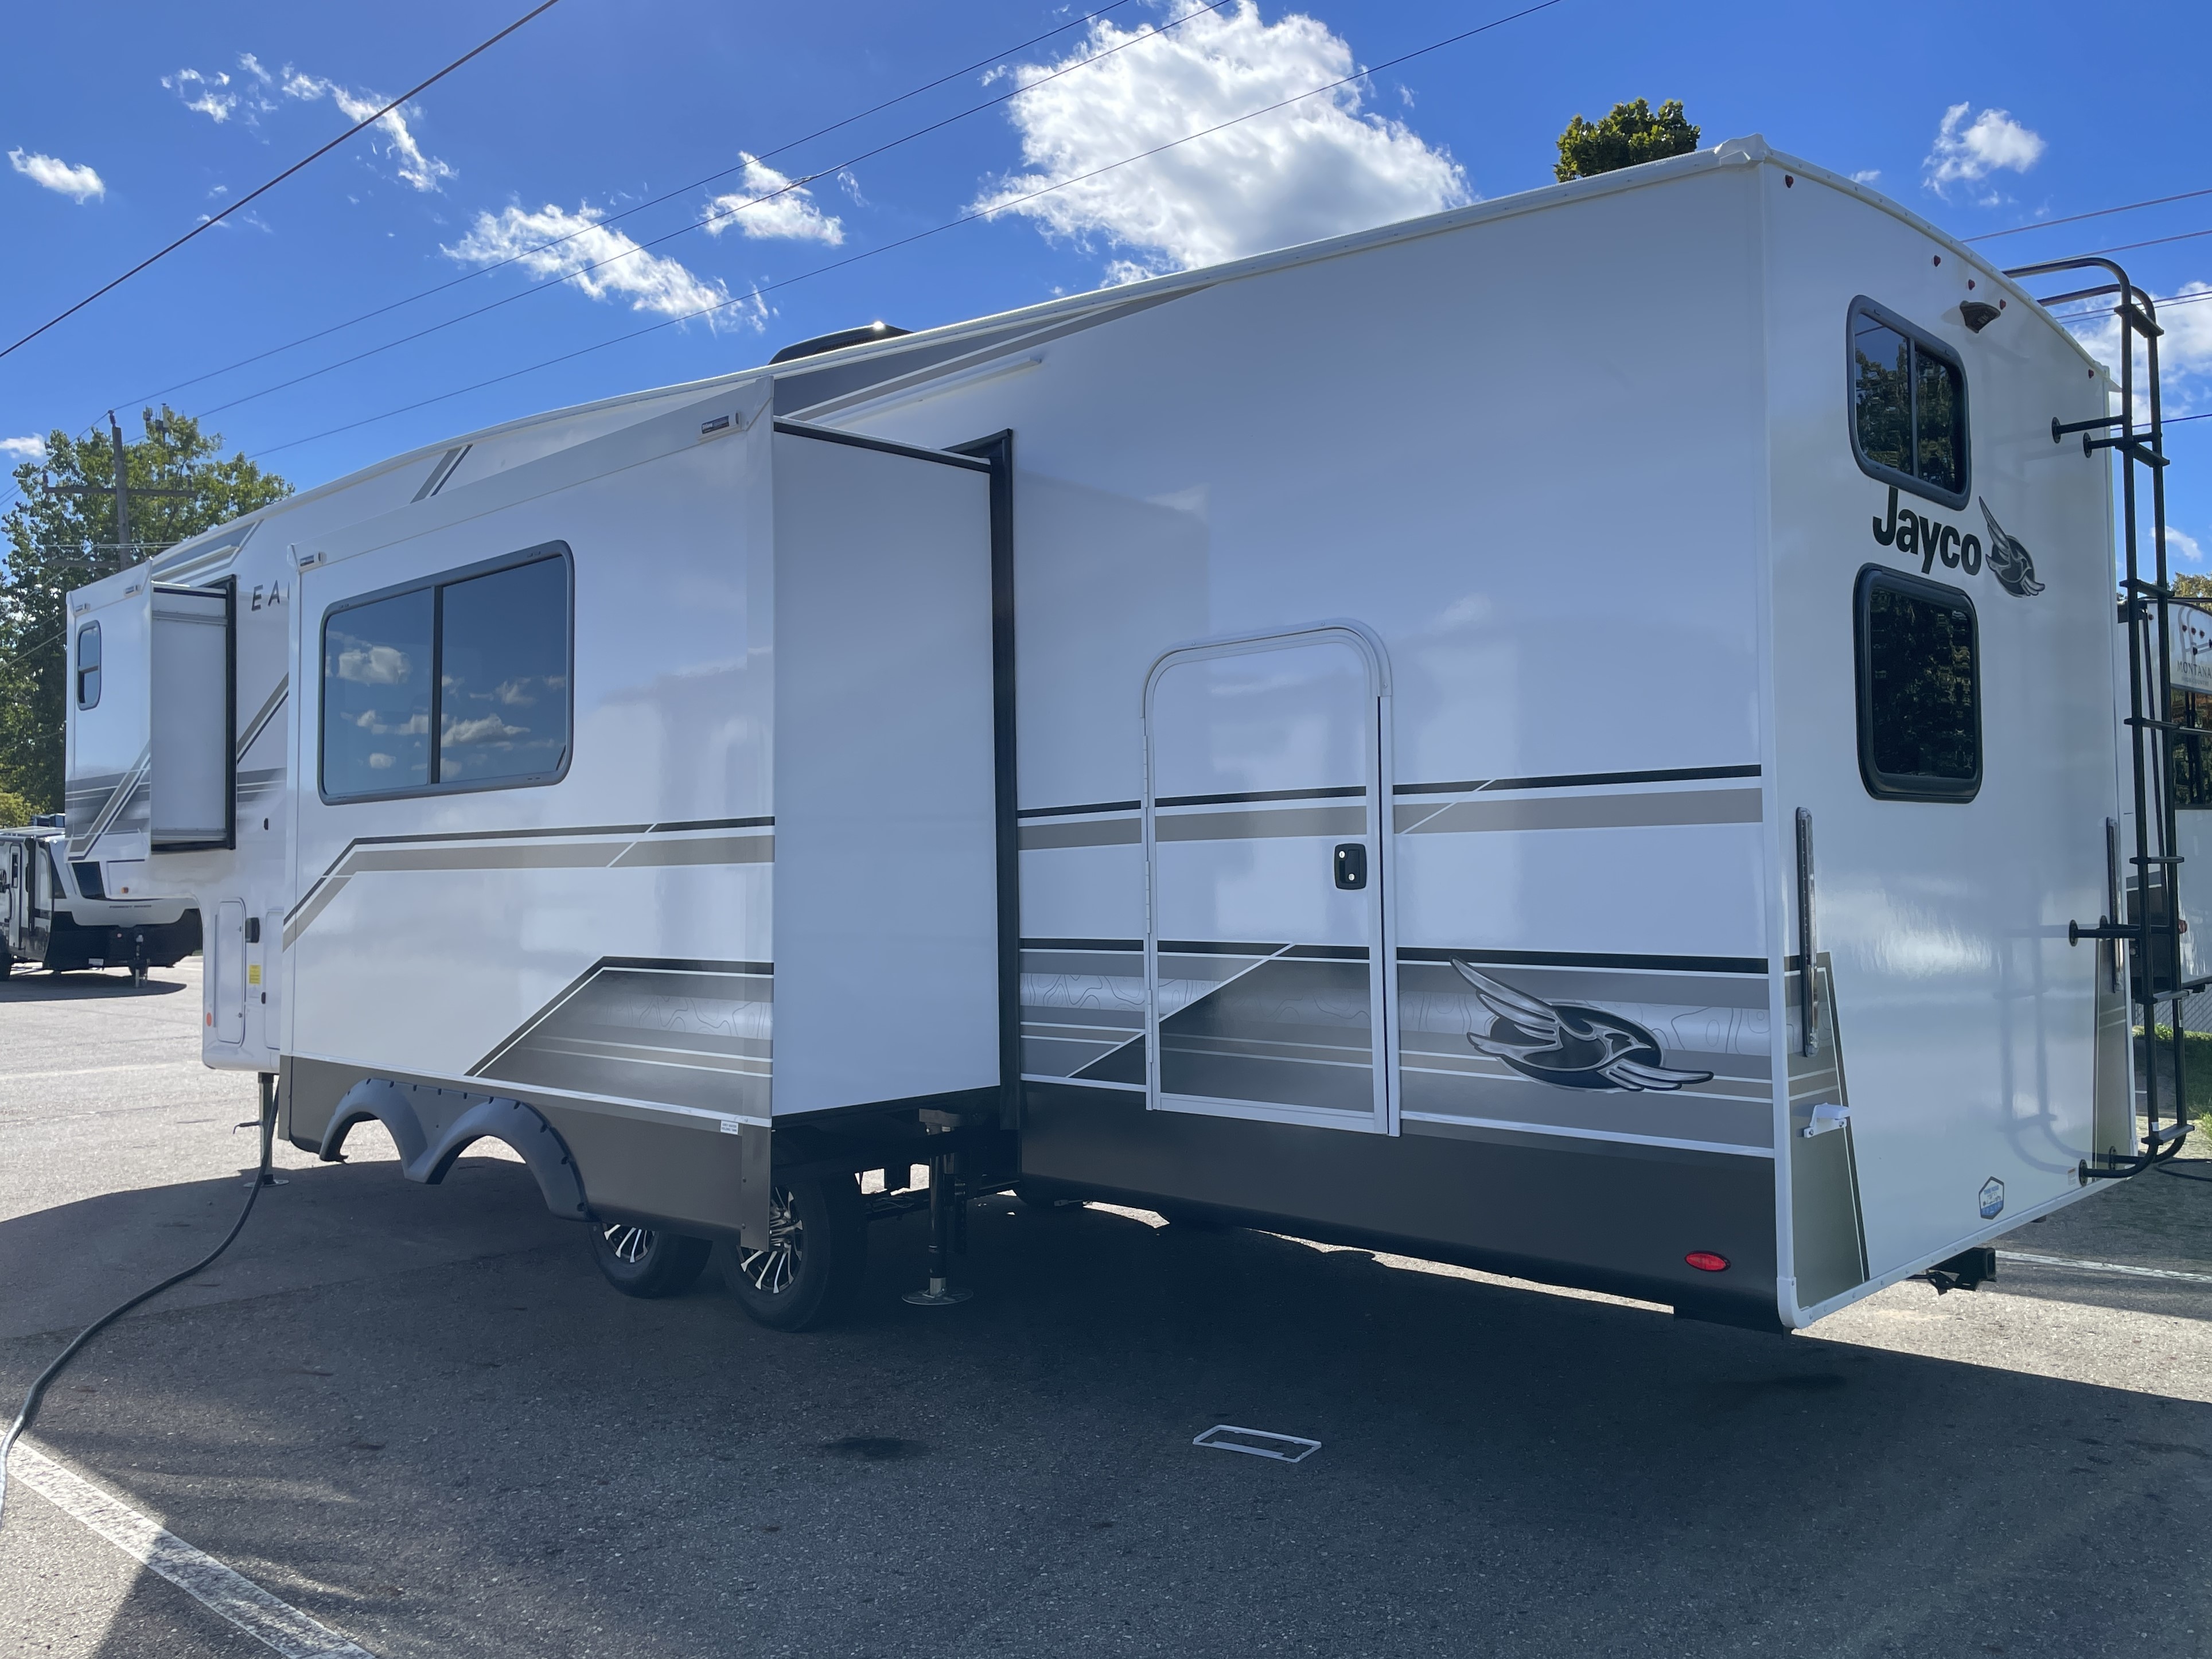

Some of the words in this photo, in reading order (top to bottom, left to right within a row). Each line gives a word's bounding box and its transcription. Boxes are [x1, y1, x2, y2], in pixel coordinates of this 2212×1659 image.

[1872, 486, 1982, 575] Jayco
[251, 579, 289, 612] EA
[2176, 660, 2212, 679] MONTANA
